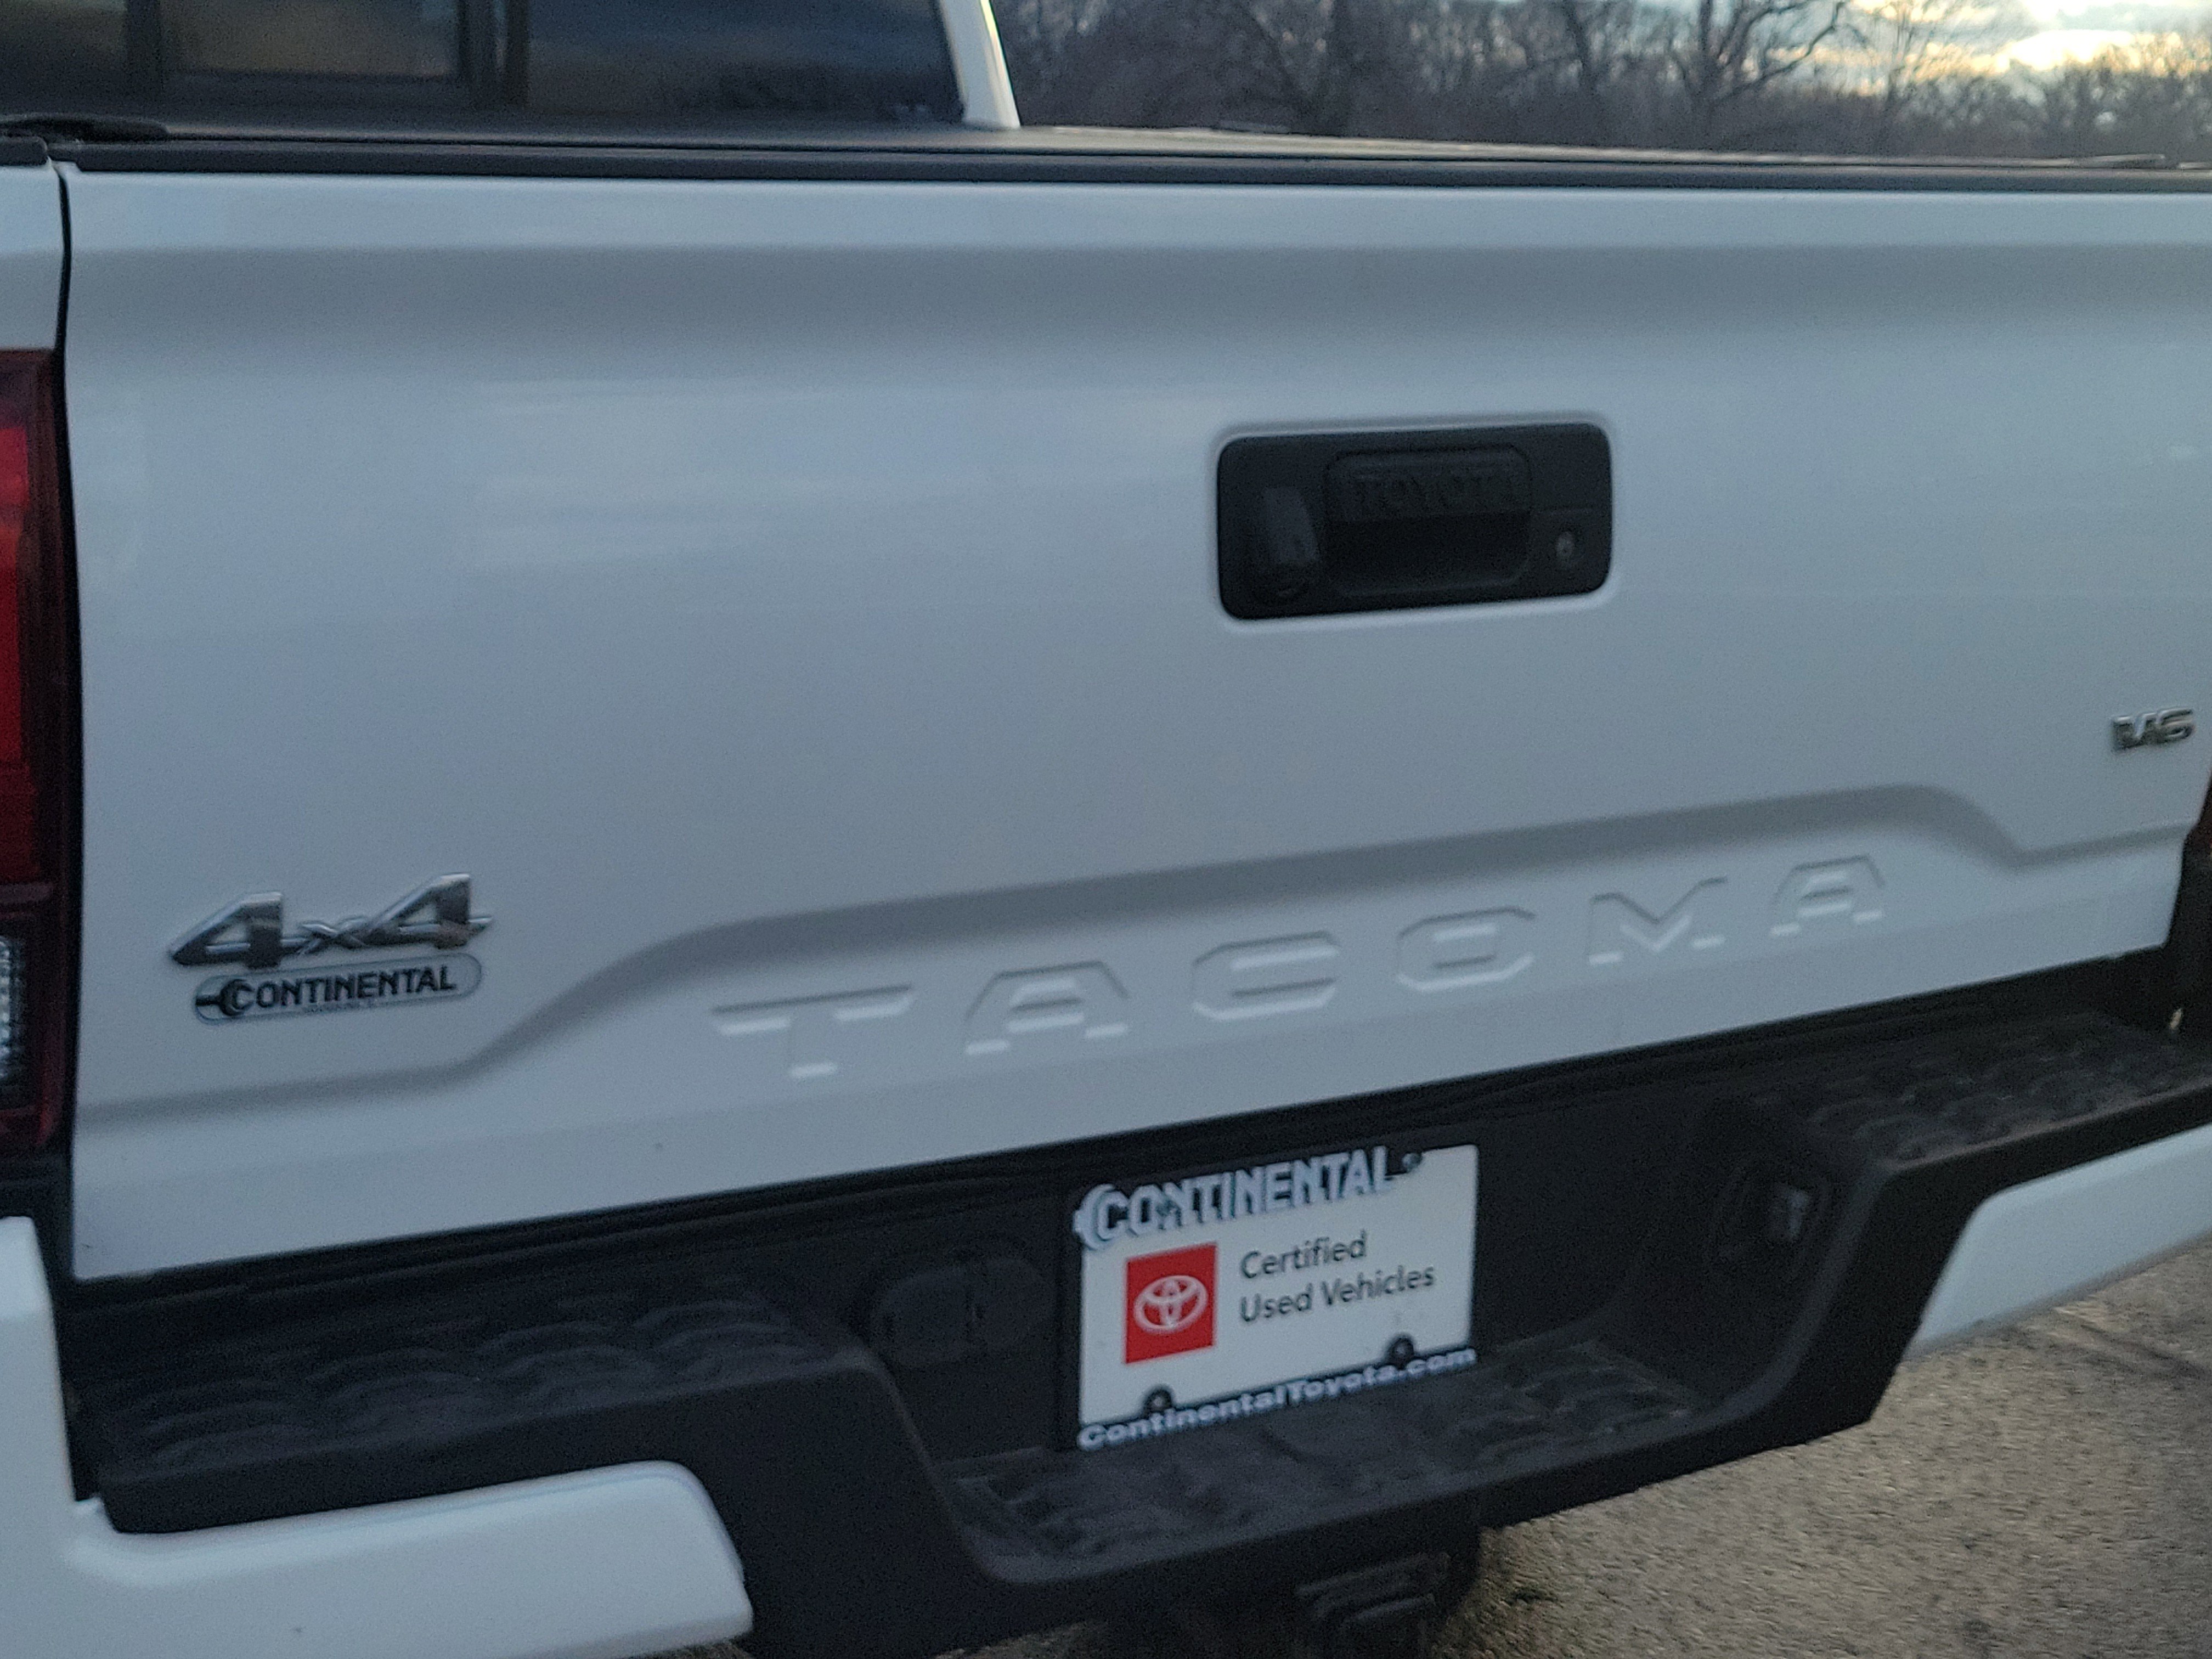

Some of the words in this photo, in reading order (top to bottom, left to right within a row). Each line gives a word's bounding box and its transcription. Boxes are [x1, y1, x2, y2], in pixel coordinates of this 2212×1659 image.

[219, 968, 456, 1015] CONTINENTAL
[713, 856, 1884, 1079] TACOMA
[1074, 1146, 1393, 1250] CONTINENTAL
[1241, 1230, 1367, 1278] Certified
[1240, 1283, 1313, 1323] Used
[1321, 1265, 1435, 1307] Vehicles
[1077, 1348, 1476, 1449] ContinentalToyota.com
